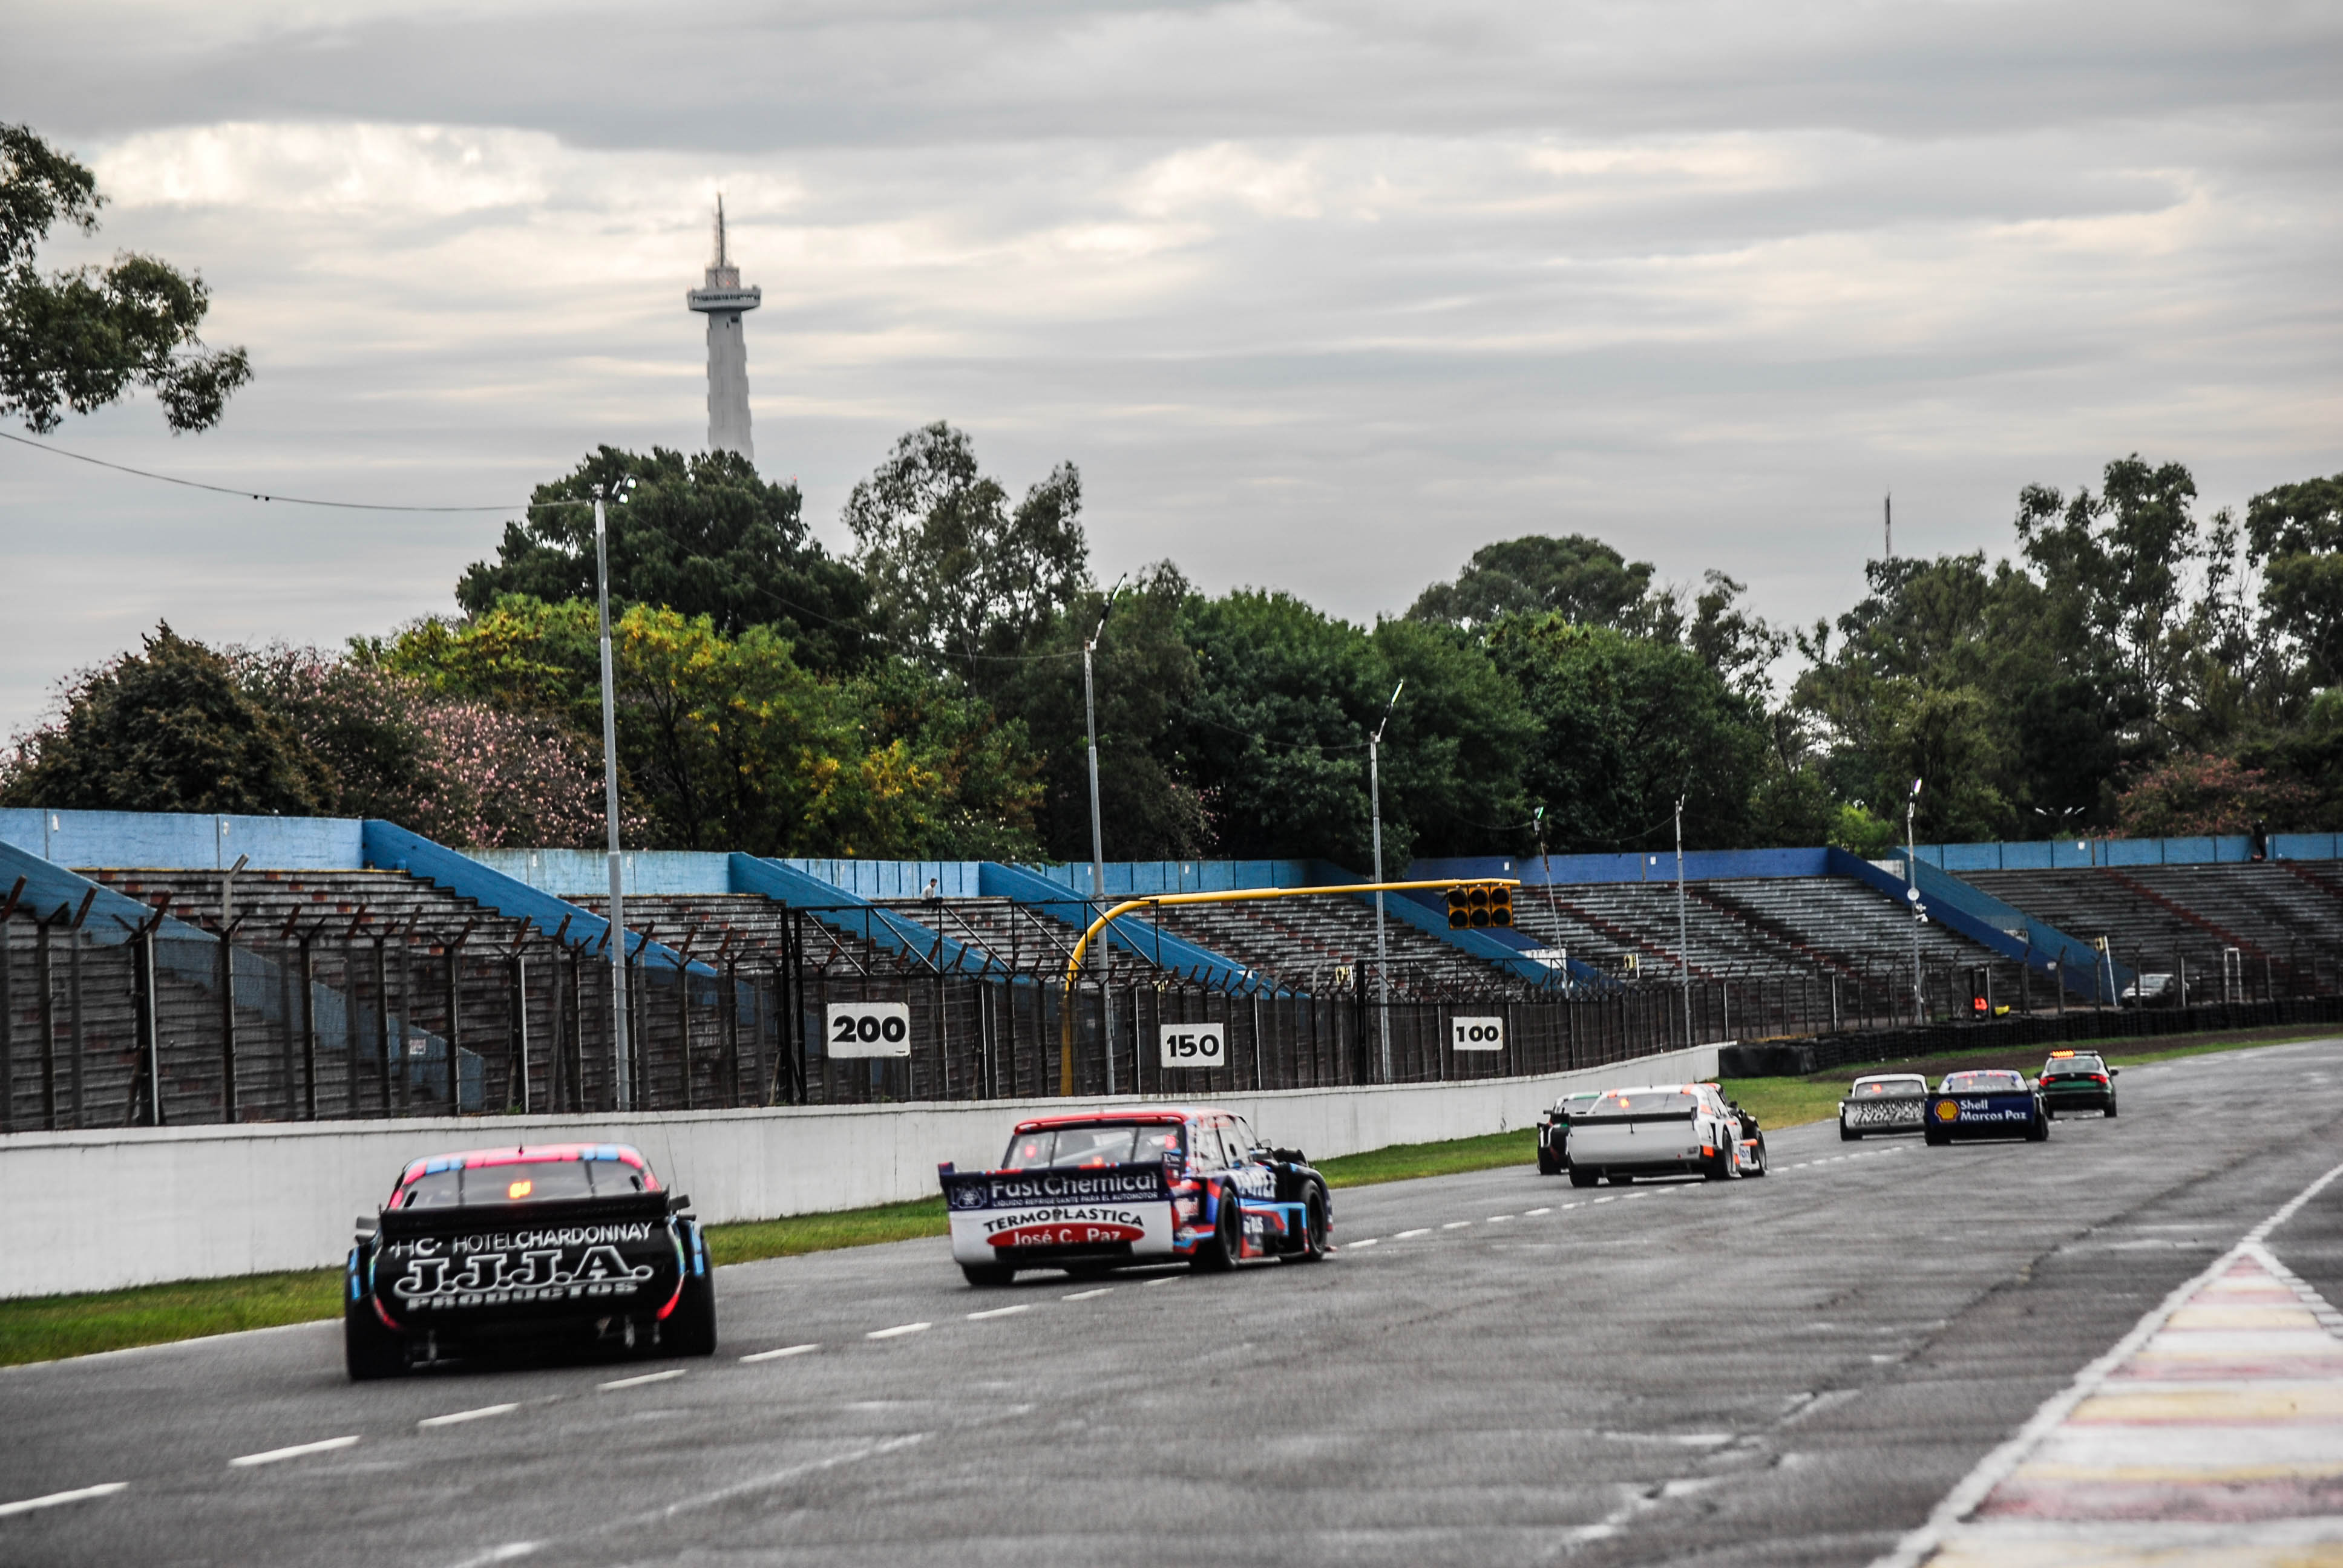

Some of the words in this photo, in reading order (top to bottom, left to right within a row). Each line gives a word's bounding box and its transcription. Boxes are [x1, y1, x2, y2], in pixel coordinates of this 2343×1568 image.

[832, 1015, 906, 1042] 200
[1456, 1025, 1499, 1042] 100
[1167, 1034, 1219, 1057] 150
[1960, 1099, 1988, 1110] Shell
[1961, 1111, 2002, 1121] Marcos
[2005, 1109, 2027, 1120] Paz
[1112, 1192, 1158, 1201] AUTOMOTOR
[983, 1208, 1144, 1232] TERMOPLASTICA
[1013, 1229, 1053, 1246] José
[1087, 1228, 1121, 1243] Paz
